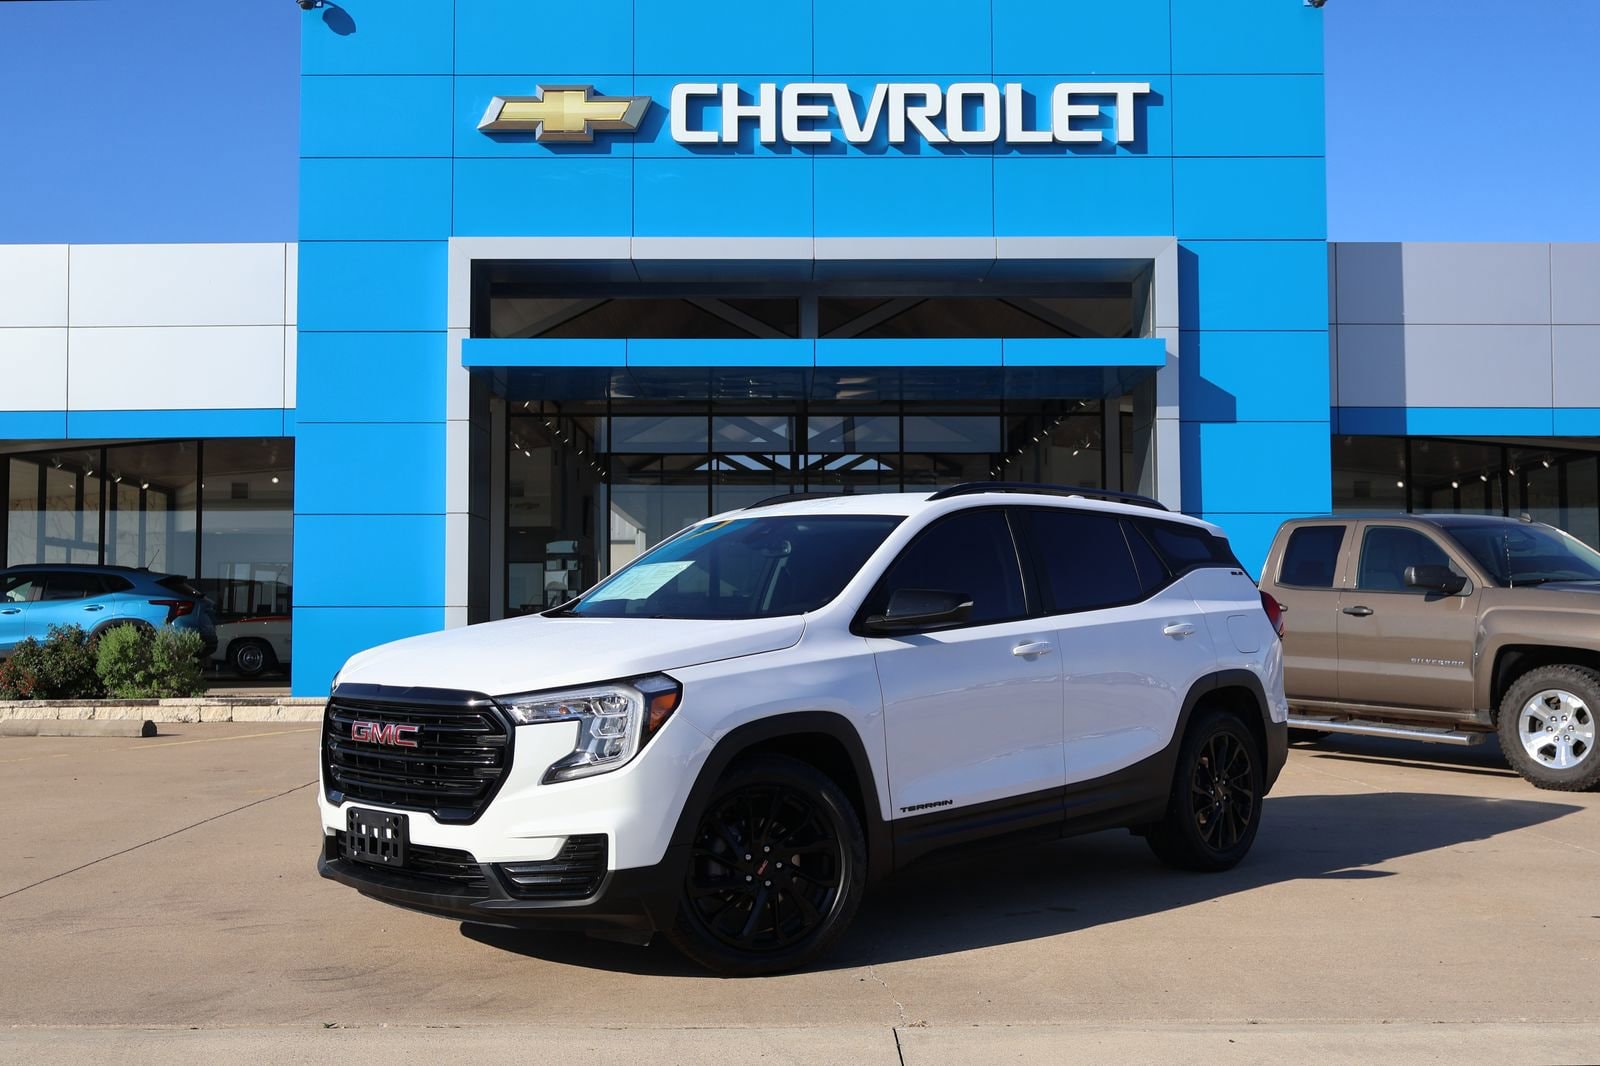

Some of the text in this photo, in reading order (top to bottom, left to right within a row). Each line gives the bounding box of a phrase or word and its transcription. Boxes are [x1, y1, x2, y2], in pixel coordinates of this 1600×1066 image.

[670, 82, 1150, 143] CHEVROLET
[351, 720, 420, 748] GMC
[900, 799, 954, 813] TERRAIN
